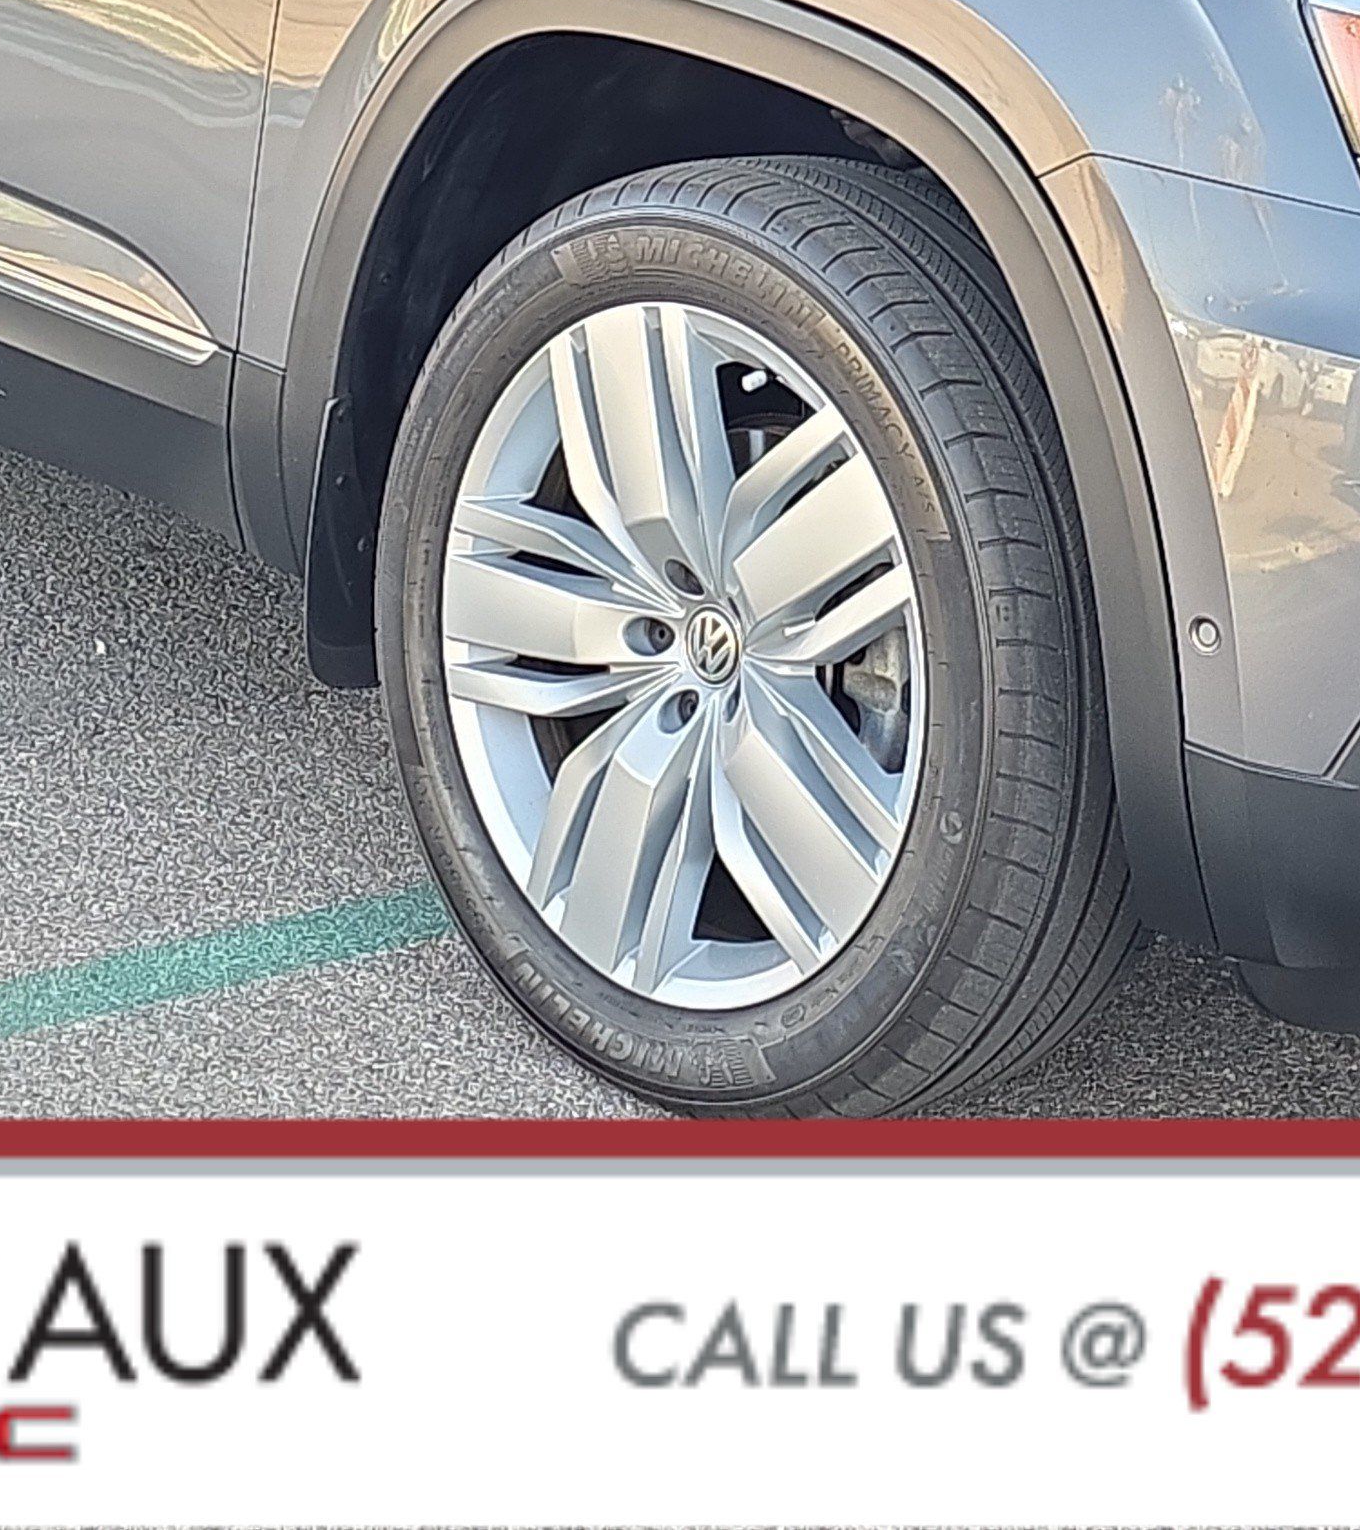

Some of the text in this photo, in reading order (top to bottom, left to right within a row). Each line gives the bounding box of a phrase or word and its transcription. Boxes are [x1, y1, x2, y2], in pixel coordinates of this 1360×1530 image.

[638, 233, 826, 328] MICHELIN
[836, 341, 915, 461] PRIMACY
[509, 963, 686, 1084] MICHELIN
